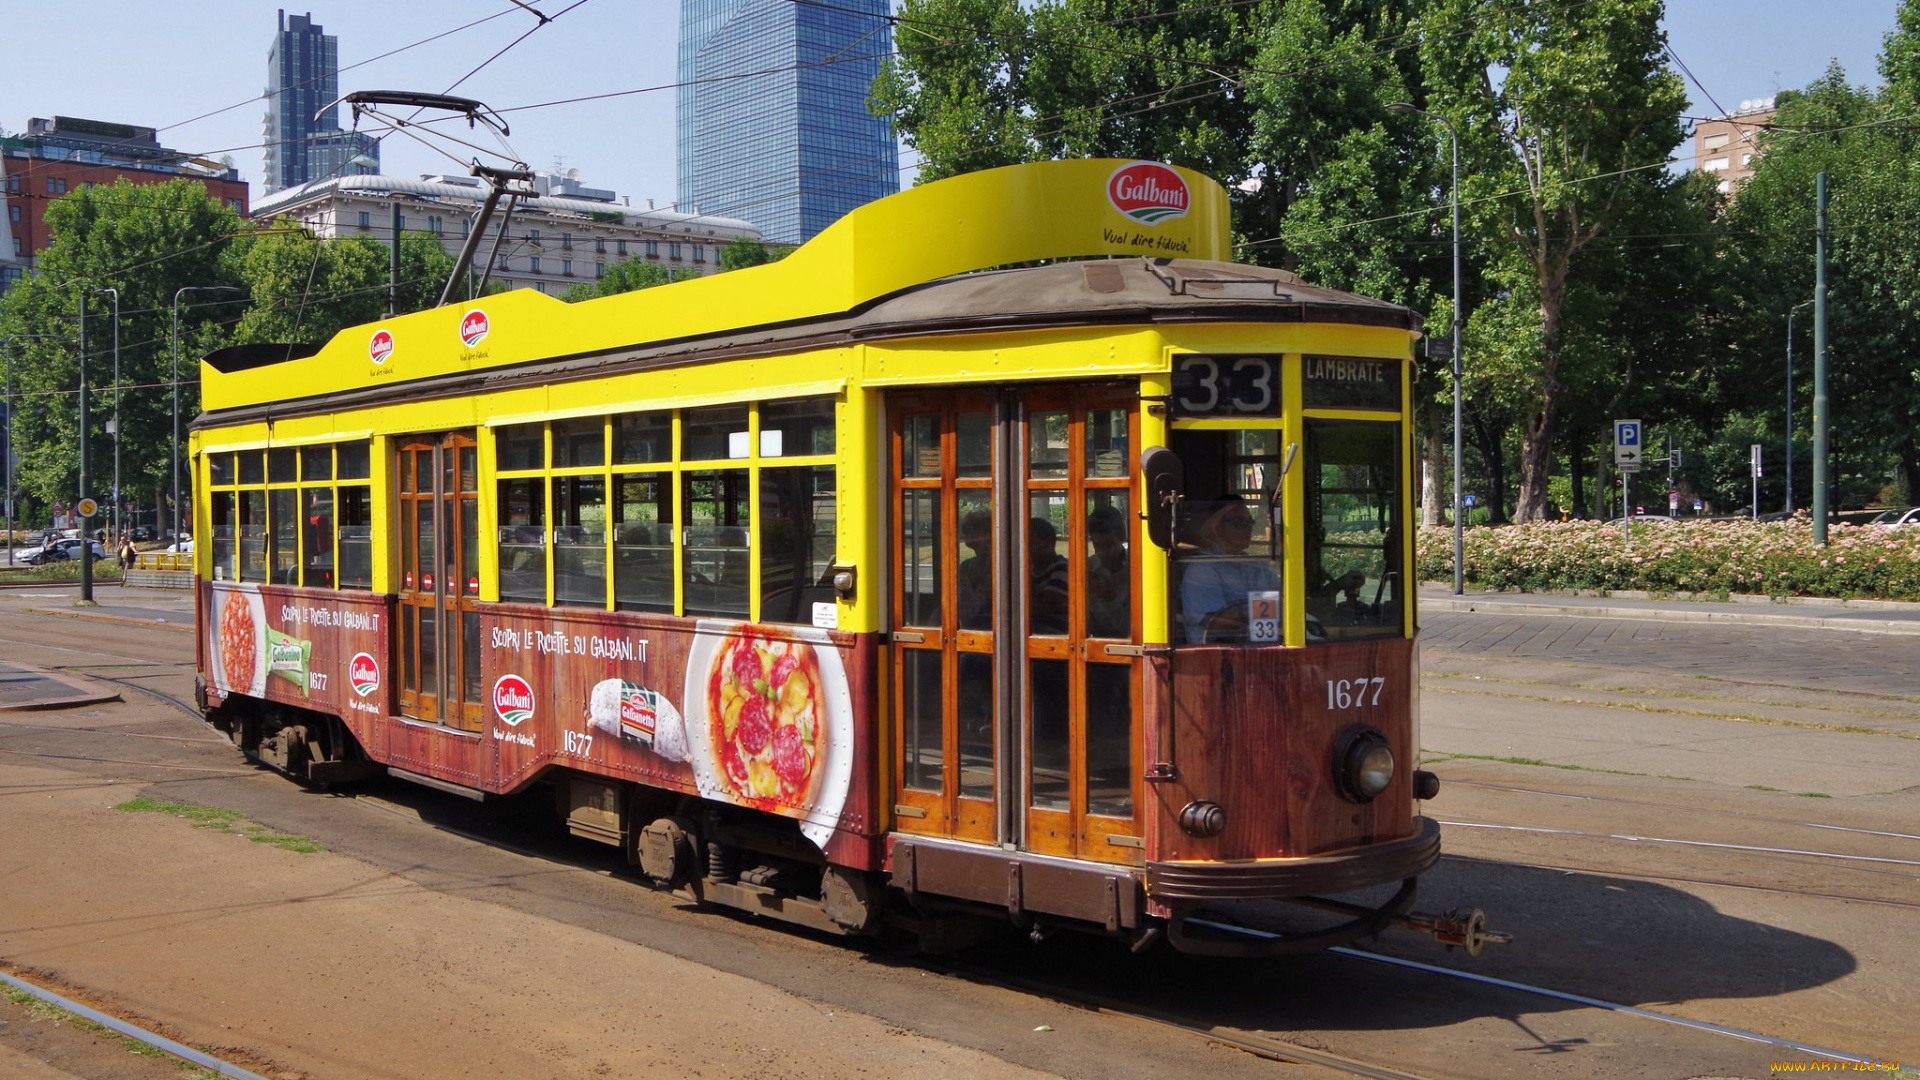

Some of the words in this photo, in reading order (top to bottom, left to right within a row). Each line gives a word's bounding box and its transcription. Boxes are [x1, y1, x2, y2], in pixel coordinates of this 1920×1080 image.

[1116, 176, 1184, 206] Galbani
[1104, 228, 1128, 244] Vuol
[1132, 232, 1154, 248] dire
[1306, 358, 1384, 382] LAMBRATE
[1180, 358, 1272, 412] 33
[1622, 428, 1634, 444] P
[282, 604, 300, 624] SCOPRI
[302, 606, 308, 622] LE
[310, 608, 330, 626] RICETTE
[332, 612, 342, 626] SU
[1260, 602, 1270, 618] 2
[492, 626, 520, 652] SCOPRI
[524, 628, 534, 650] LE
[534, 630, 570, 656] RICETTE
[574, 636, 586, 656] SU
[1256, 622, 1274, 638] 33
[310, 672, 328, 690] 1677
[1326, 676, 1386, 710] 1677
[498, 686, 530, 710] Galbani
[564, 730, 592, 756] 1677
